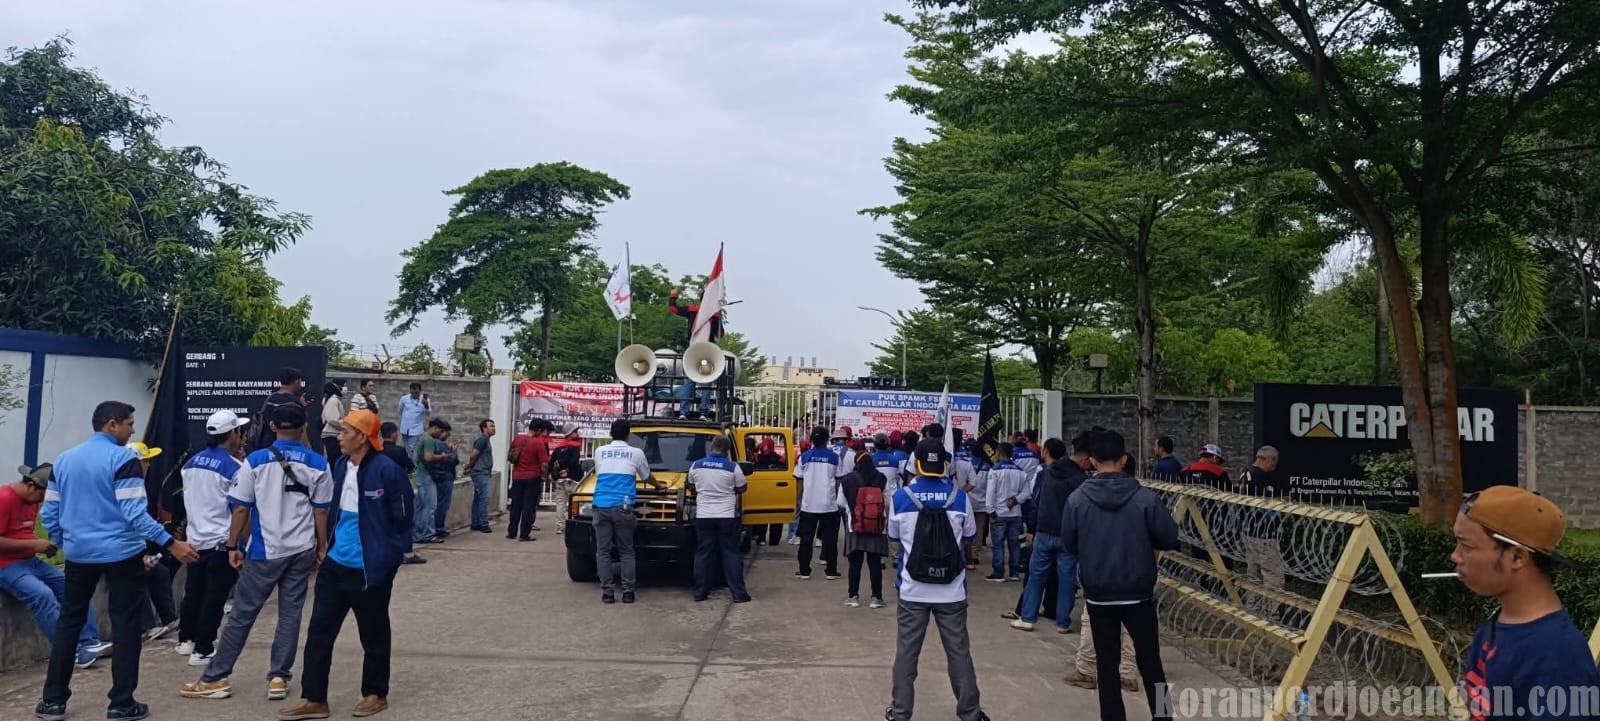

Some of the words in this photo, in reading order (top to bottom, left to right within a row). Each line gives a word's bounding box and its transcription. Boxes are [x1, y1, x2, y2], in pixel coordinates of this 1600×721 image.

[856, 400, 911, 408] CATERPILLAR
[897, 395, 926, 403] SPAMK
[1290, 402, 1495, 442] CATERPAR
[601, 450, 632, 460] FSPMI
[1289, 476, 1299, 486] PT
[1302, 477, 1341, 488] Caterpillar
